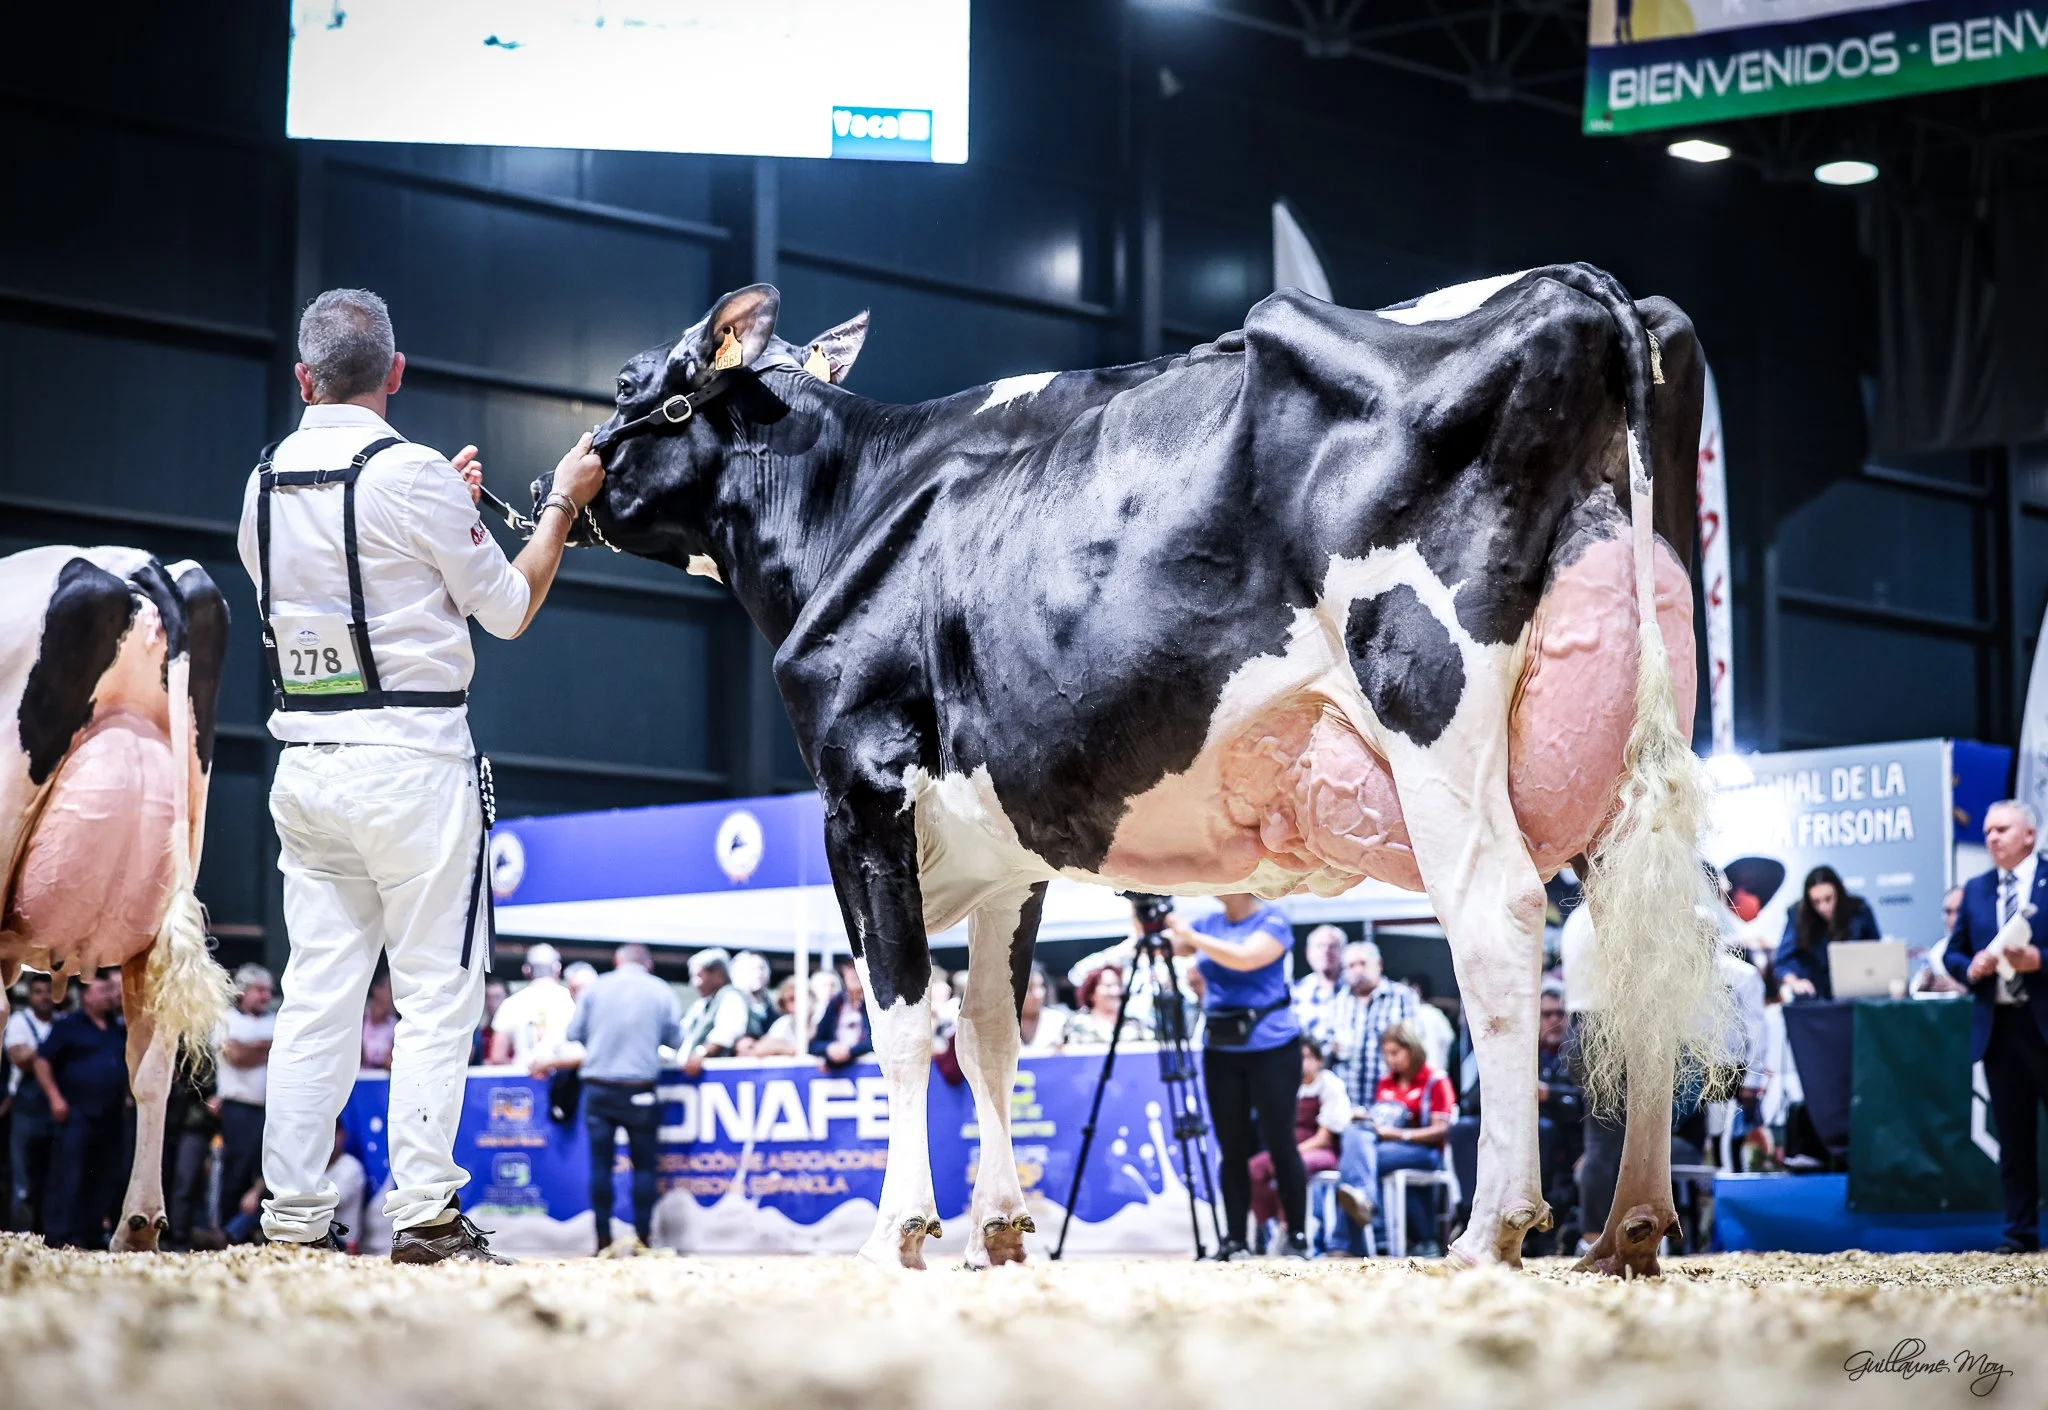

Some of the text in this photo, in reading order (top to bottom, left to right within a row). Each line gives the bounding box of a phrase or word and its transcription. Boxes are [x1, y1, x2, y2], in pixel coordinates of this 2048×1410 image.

[1607, 31, 1900, 110] BIENVENIDOS
[290, 646, 343, 676] 278
[1830, 765, 1866, 803] DE
[1870, 760, 1906, 800] LA
[1796, 804, 1915, 848] FRISONA
[656, 1076, 889, 1144] ONAFE
